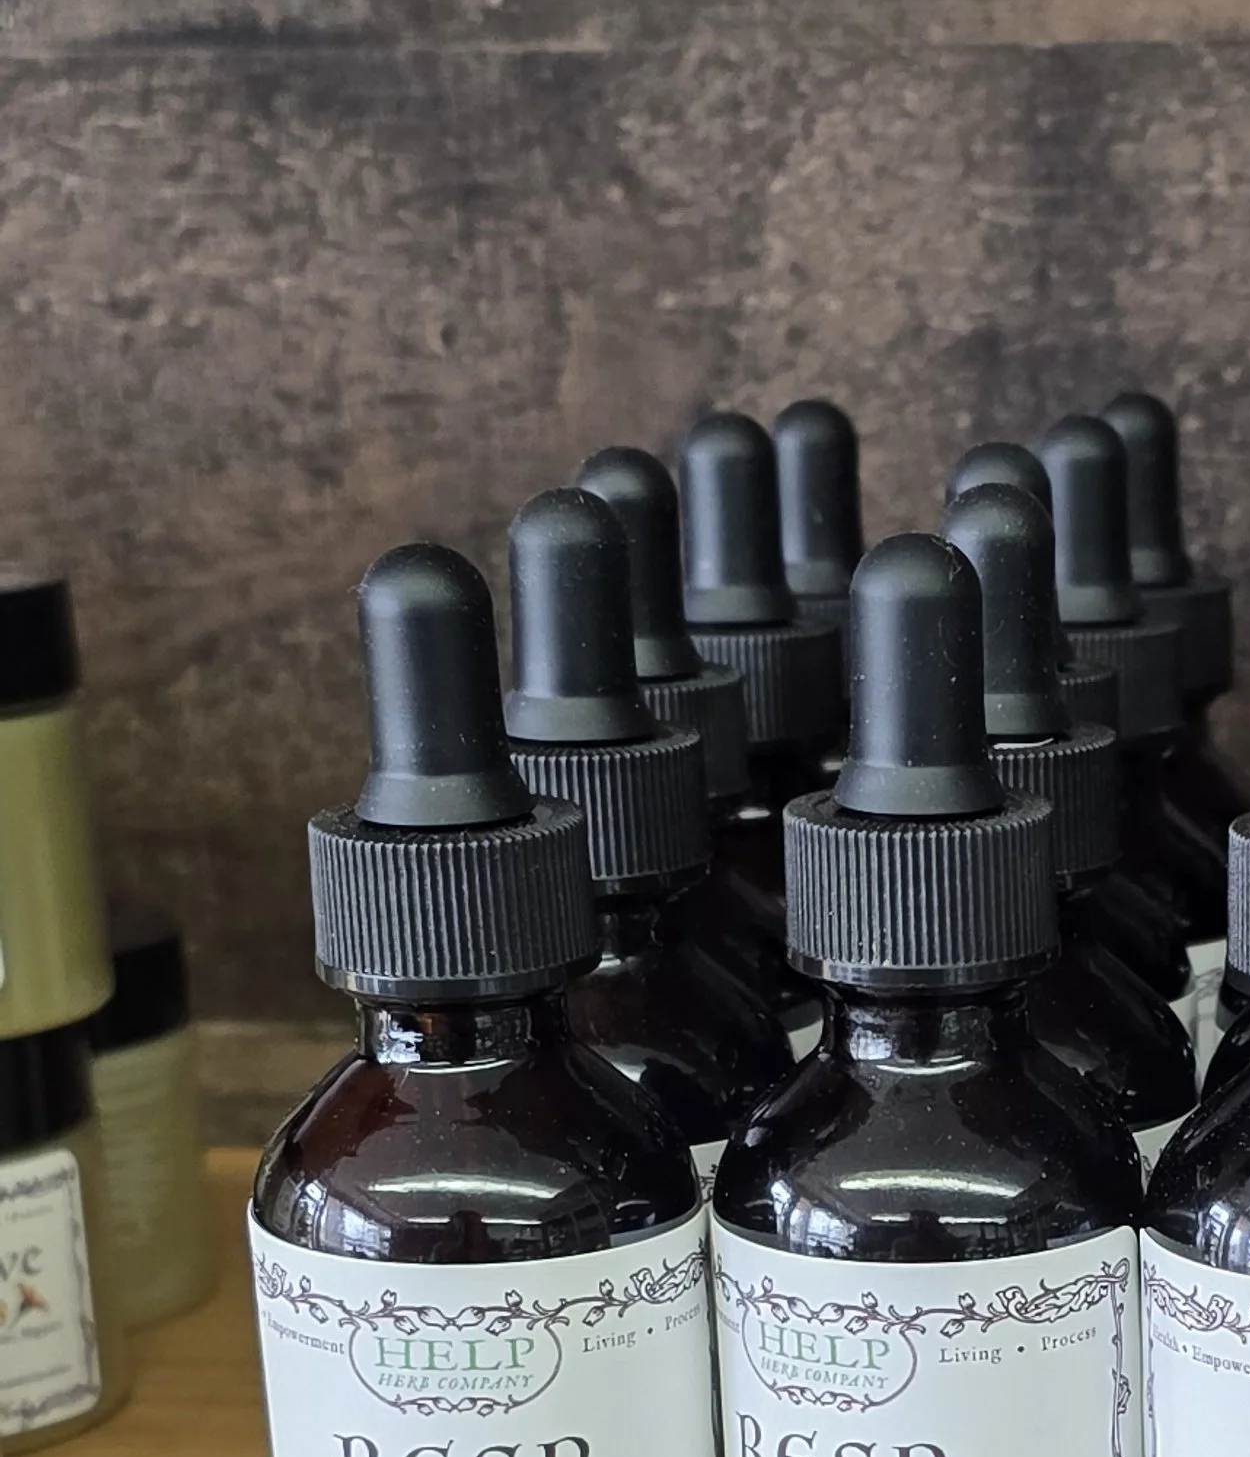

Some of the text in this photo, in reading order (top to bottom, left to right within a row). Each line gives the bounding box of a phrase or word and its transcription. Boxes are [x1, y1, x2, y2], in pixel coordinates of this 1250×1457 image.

[582, 1331, 636, 1352] Living
[758, 1321, 890, 1371] HELP
[1040, 1326, 1097, 1351] Process
[374, 1336, 535, 1371] HELP
[938, 1347, 1002, 1364] Living
[378, 1372, 534, 1392] HERB COMPANY
[760, 1356, 889, 1389] HERB COMPANY
